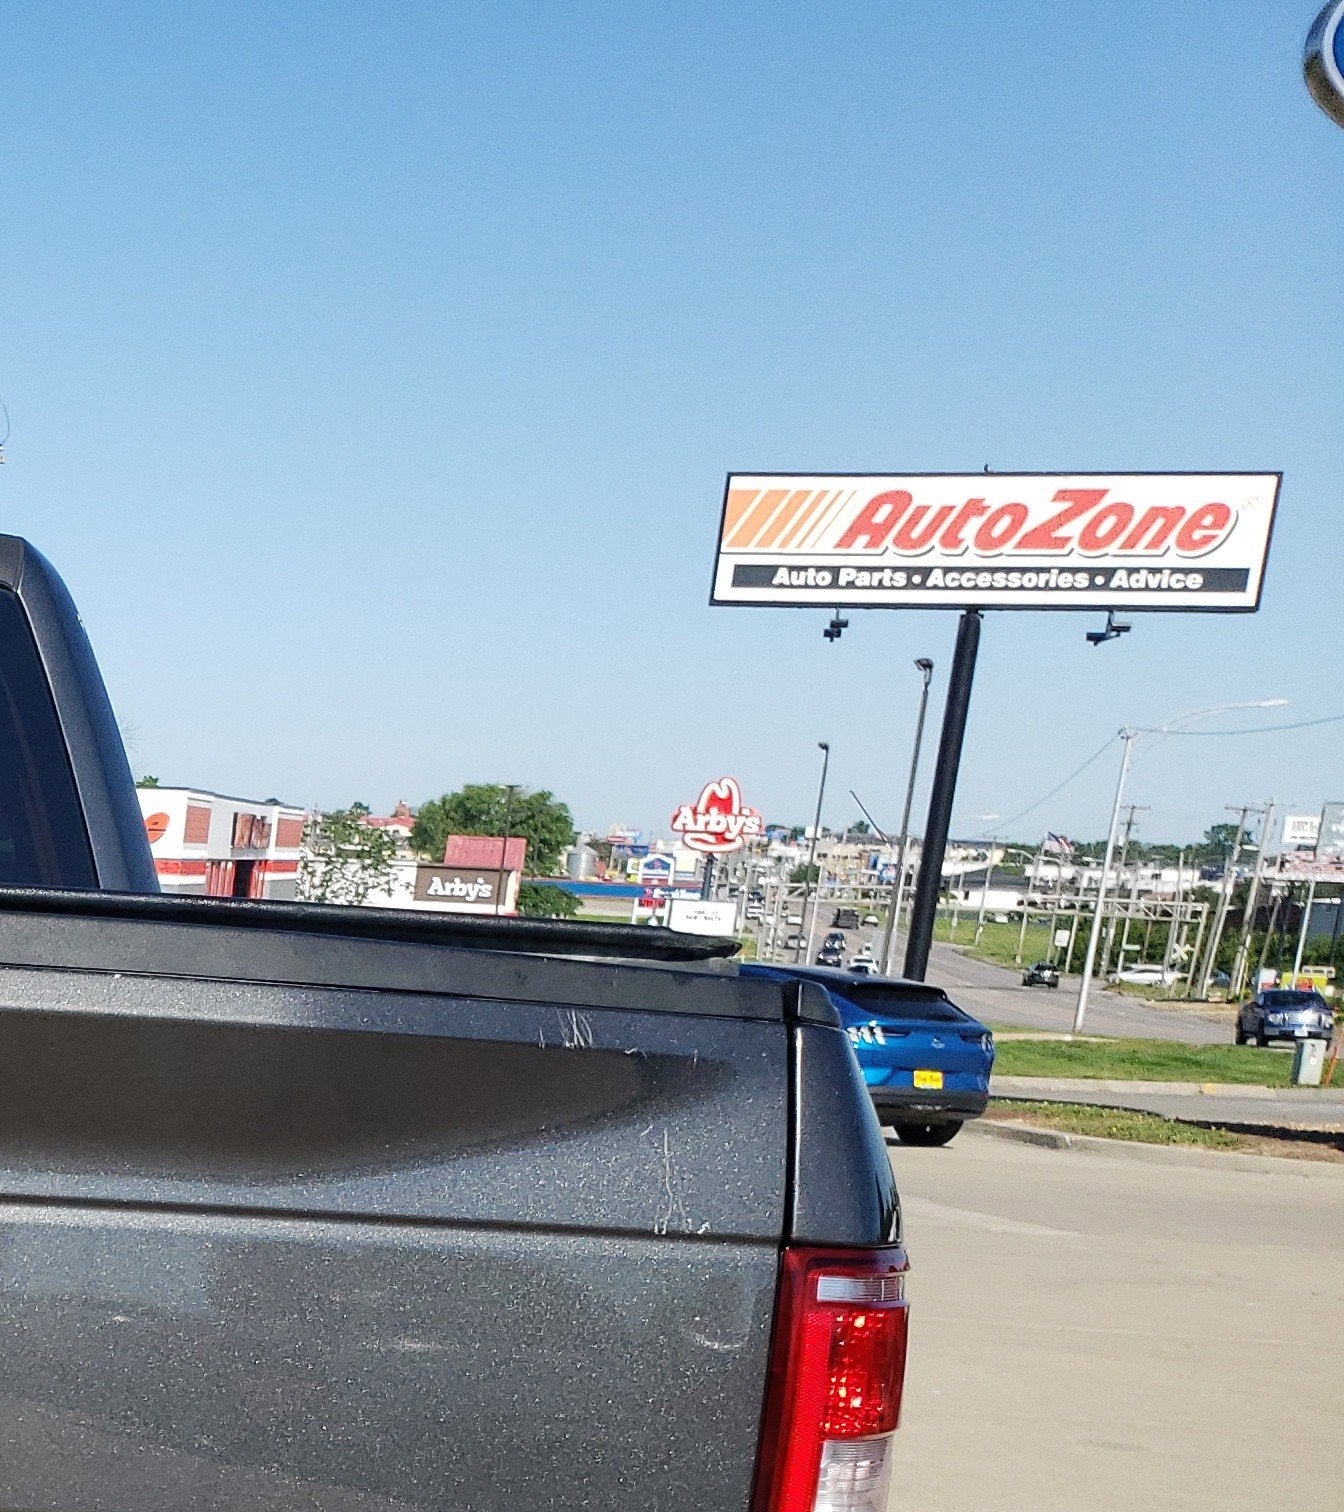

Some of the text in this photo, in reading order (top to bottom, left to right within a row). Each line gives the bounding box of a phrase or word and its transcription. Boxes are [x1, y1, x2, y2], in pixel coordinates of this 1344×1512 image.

[832, 489, 1232, 552] AutoZone
[771, 567, 1204, 590] Auto Parts Accessories Advice
[671, 805, 761, 839] Arby's
[427, 876, 493, 902] Arby's
